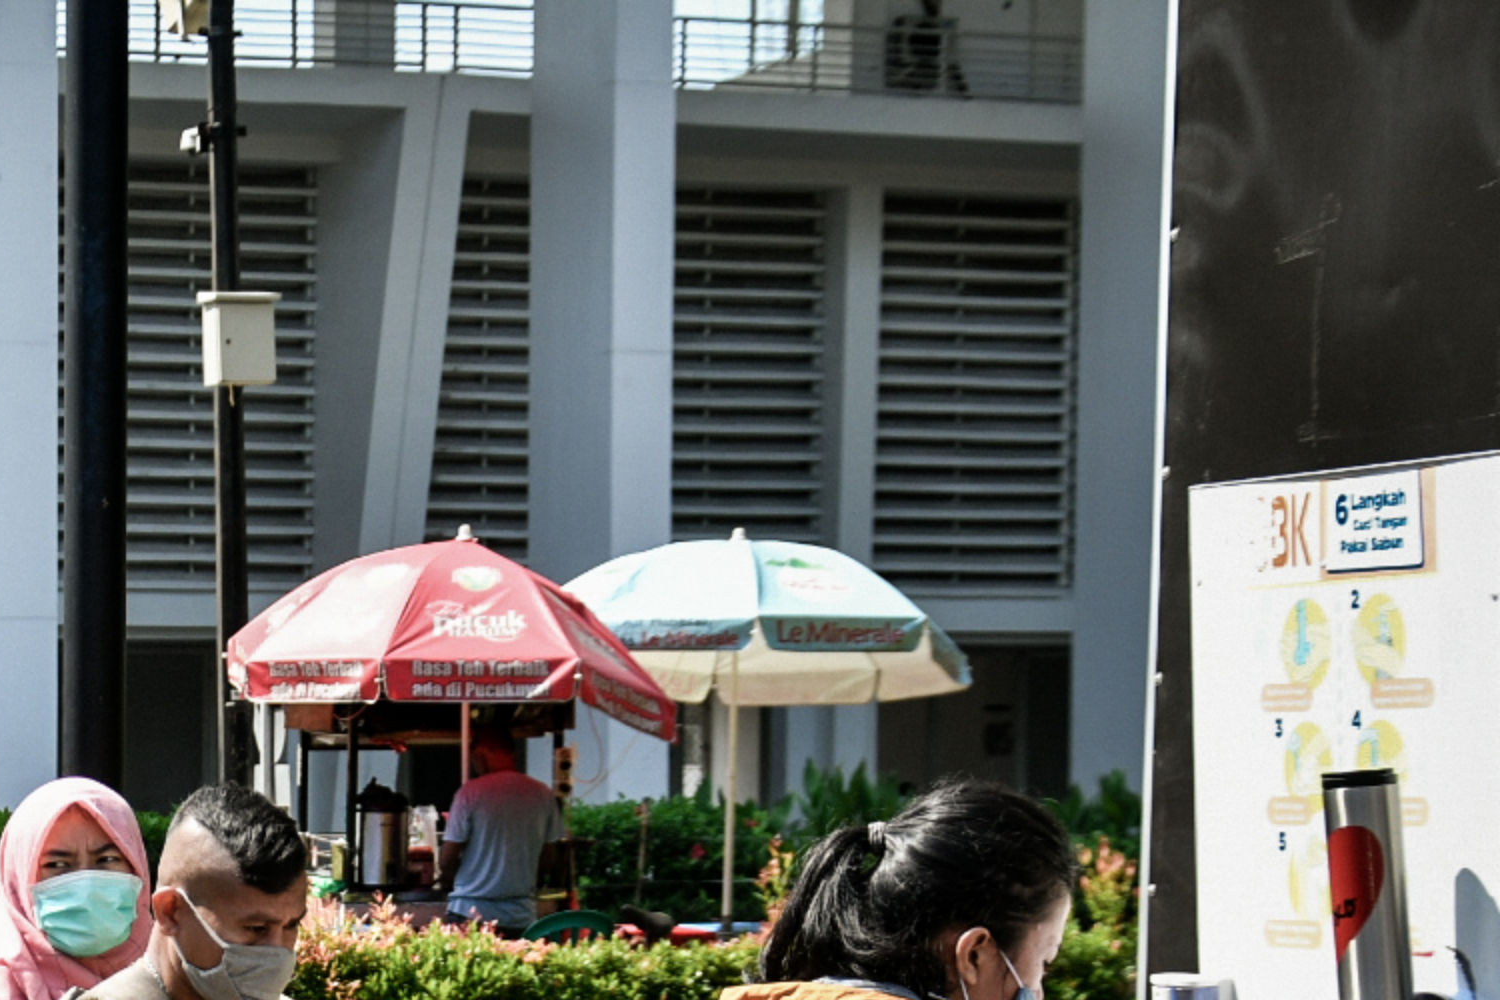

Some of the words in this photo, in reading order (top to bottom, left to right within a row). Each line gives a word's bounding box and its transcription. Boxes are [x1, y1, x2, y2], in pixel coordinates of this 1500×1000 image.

[1335, 493, 1349, 526] 6
[1351, 488, 1407, 512] Langkah
[1340, 538, 1368, 553] Pakai
[1371, 537, 1404, 551] Sabun
[1350, 589, 1360, 609] 2
[777, 620, 803, 644] Le
[806, 622, 905, 645] Minerale
[456, 660, 485, 676] Teh
[488, 660, 549, 676] Terbaik
[412, 682, 443, 697] ada
[446, 682, 462, 697] di
[1351, 710, 1362, 729] 4
